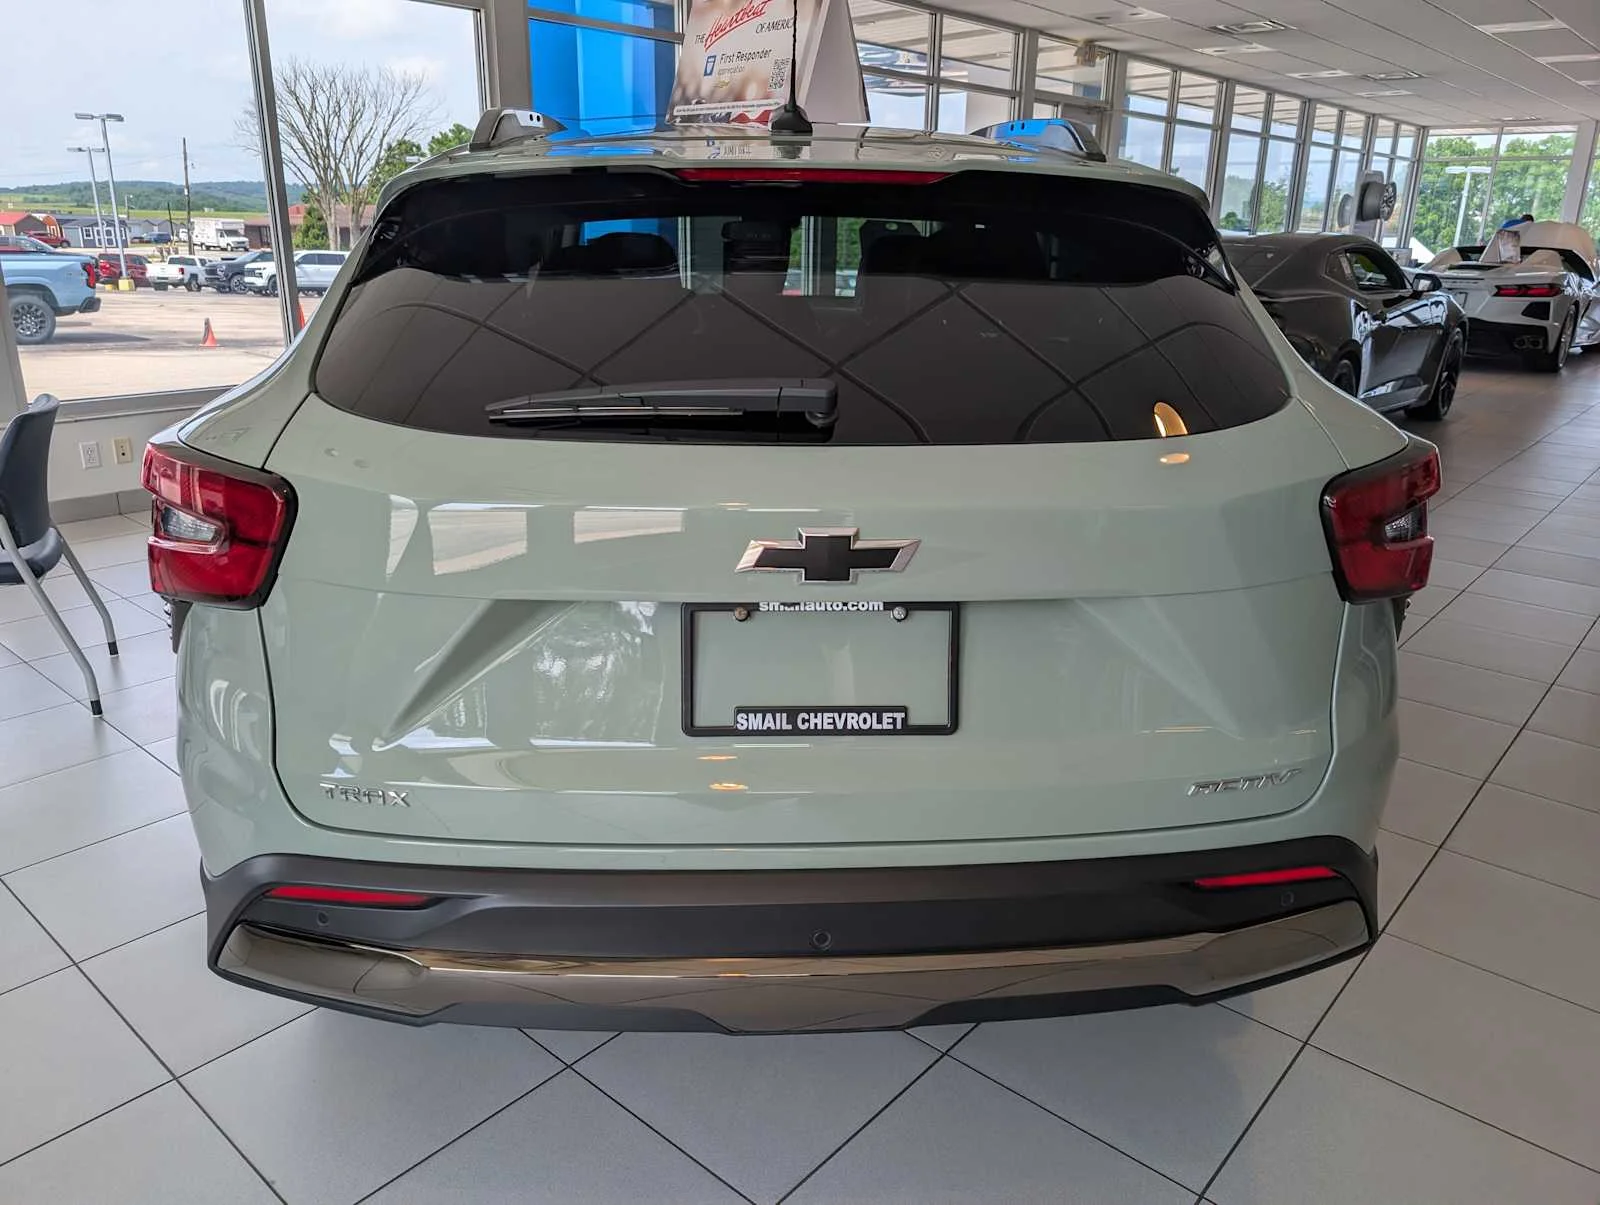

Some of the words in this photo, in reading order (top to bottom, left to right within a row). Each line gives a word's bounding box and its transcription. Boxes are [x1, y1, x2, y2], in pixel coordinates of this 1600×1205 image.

[704, 0, 771, 50] Heartbeat
[756, 23, 766, 34] OF
[765, 18, 795, 32] AMERIC
[695, 33, 706, 44] THE
[720, 53, 735, 64] First
[736, 48, 772, 62] Responder
[736, 712, 792, 730] SMAIL
[796, 712, 905, 730] CHEVROLET
[320, 782, 410, 807] TRAX
